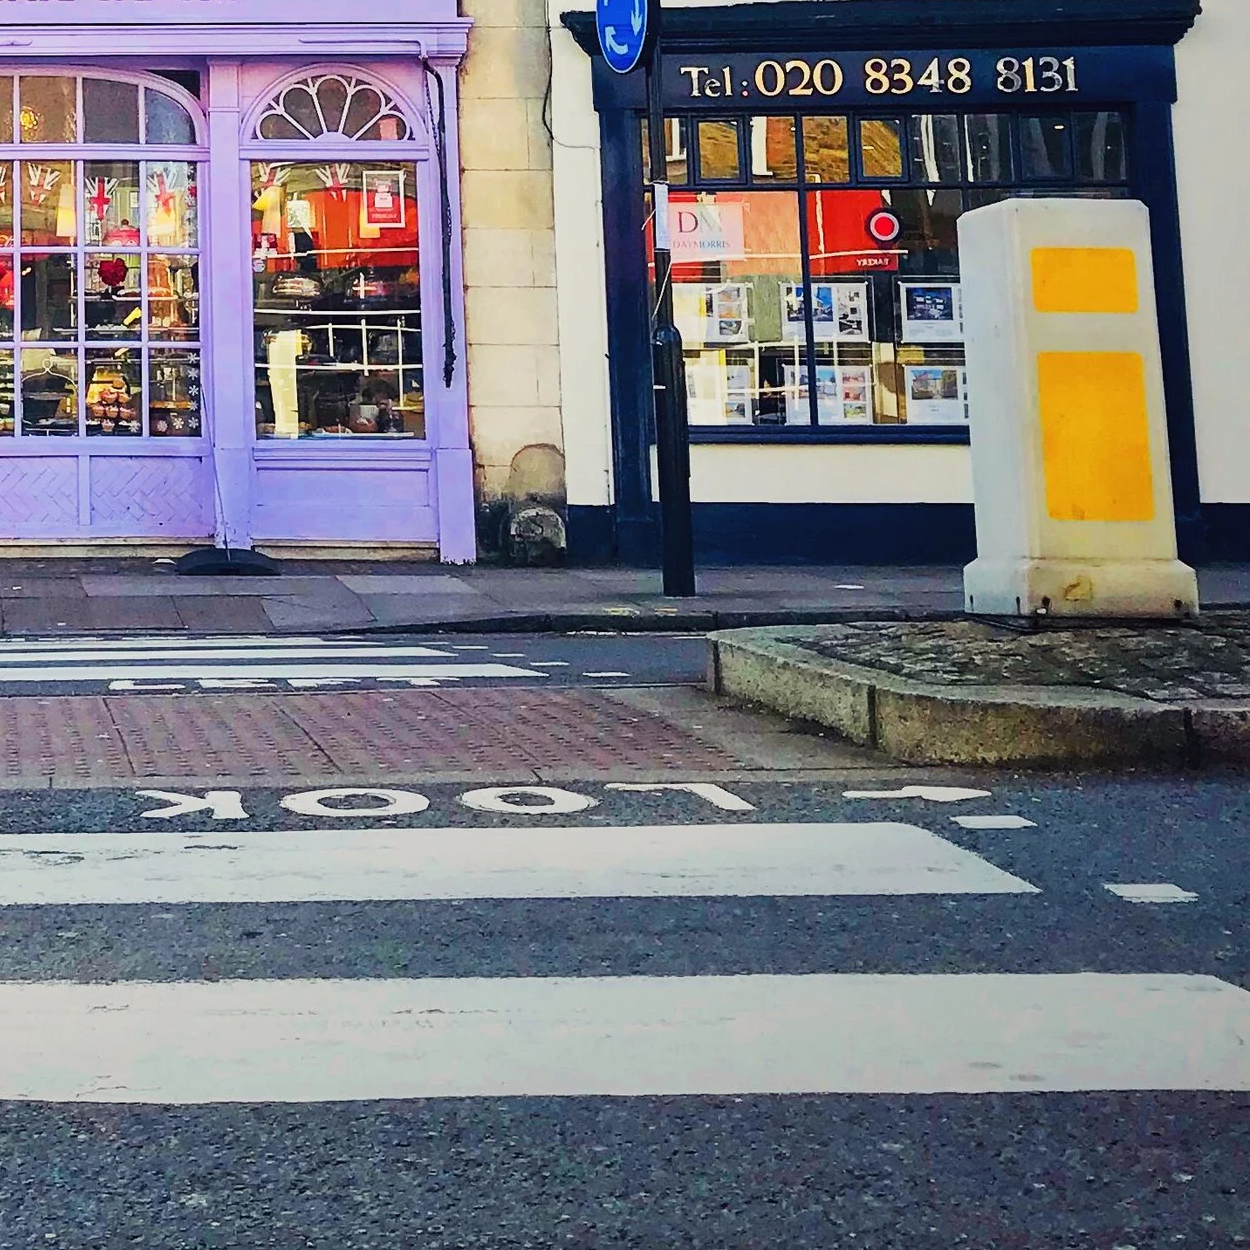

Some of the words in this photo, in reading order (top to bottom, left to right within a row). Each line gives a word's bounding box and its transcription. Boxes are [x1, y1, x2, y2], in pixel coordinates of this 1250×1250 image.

[863, 57, 972, 94] 8348
[995, 56, 1079, 93] 8131
[107, 676, 460, 690] LEFT
[135, 782, 758, 819] LOOK
